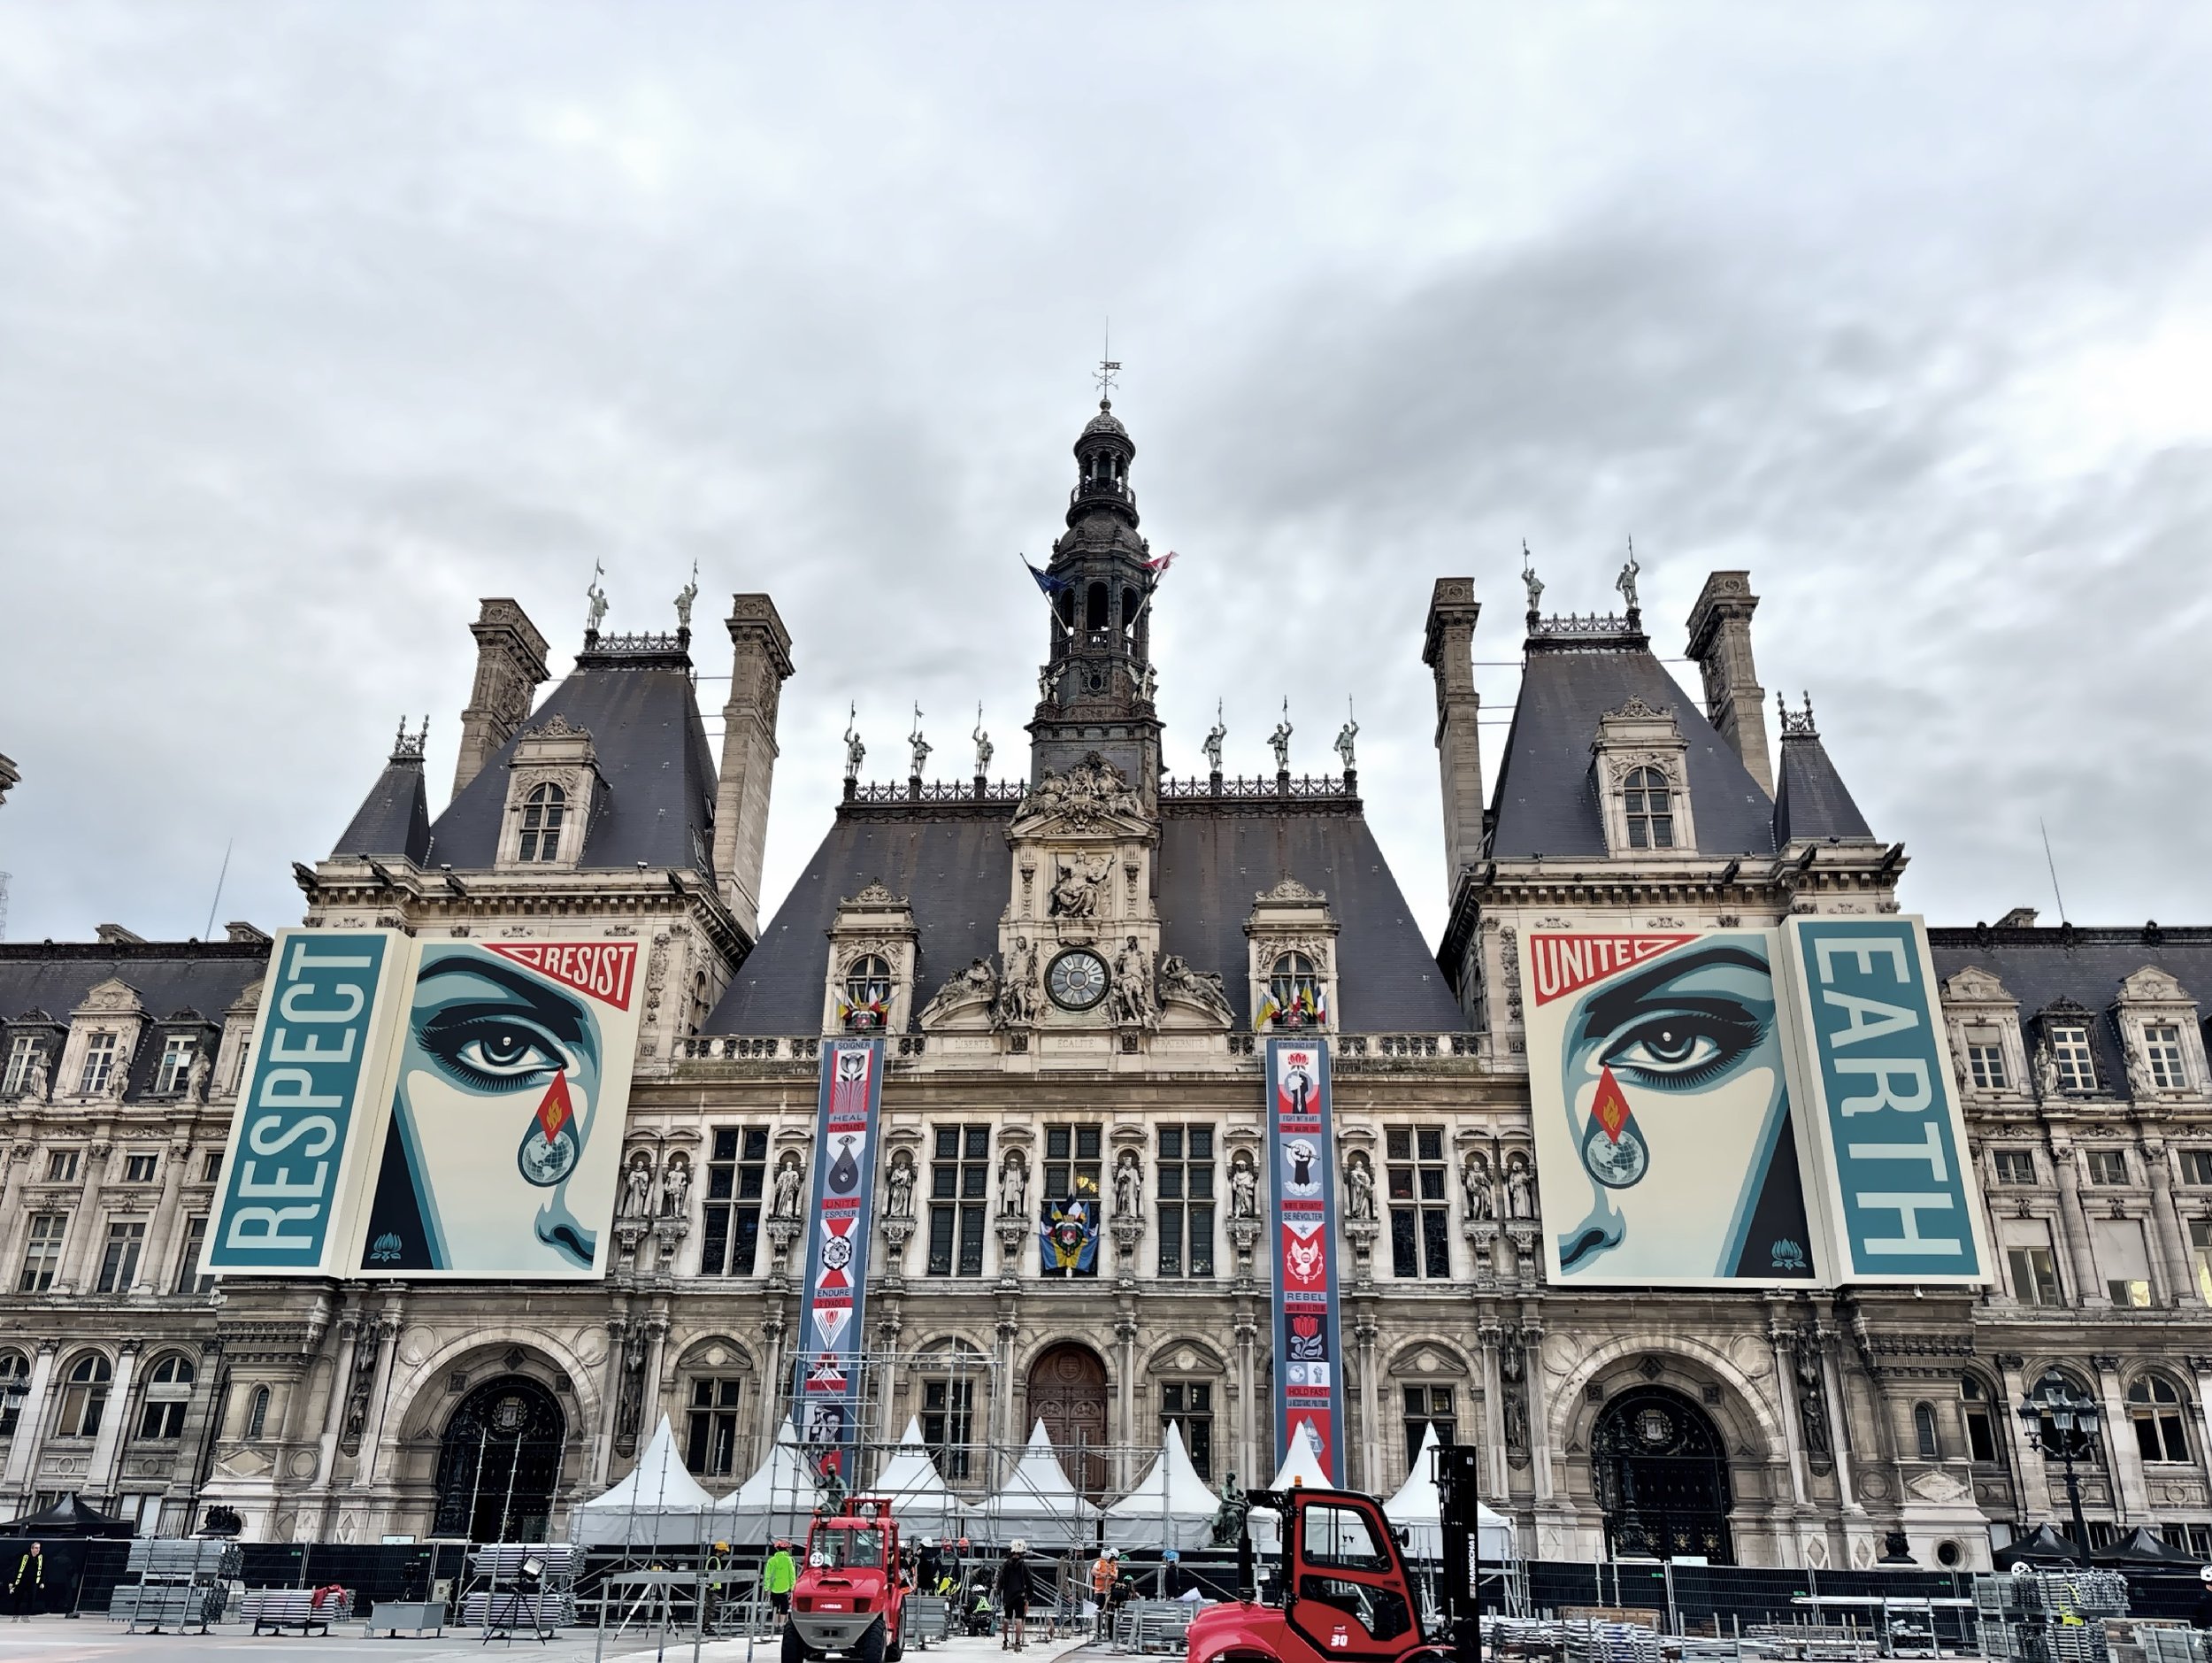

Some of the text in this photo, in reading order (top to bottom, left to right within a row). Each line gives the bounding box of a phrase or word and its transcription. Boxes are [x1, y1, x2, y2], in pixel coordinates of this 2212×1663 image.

[1534, 939, 1632, 997] UNITE
[543, 946, 635, 1003] RESIST
[226, 943, 373, 1250] RESPECT
[1815, 936, 1963, 1258] EARTH
[826, 1198, 857, 1208] UNITE
[825, 1209, 856, 1219] ESPÉRER
[1293, 1211, 1322, 1220] RÉVOLTER
[817, 1289, 850, 1297] ENDURE
[1286, 1293, 1325, 1302] REBEL
[1288, 1388, 1327, 1397] HOLD FAST
[812, 1554, 823, 1565] 25
[1331, 1634, 1348, 1647] 30
